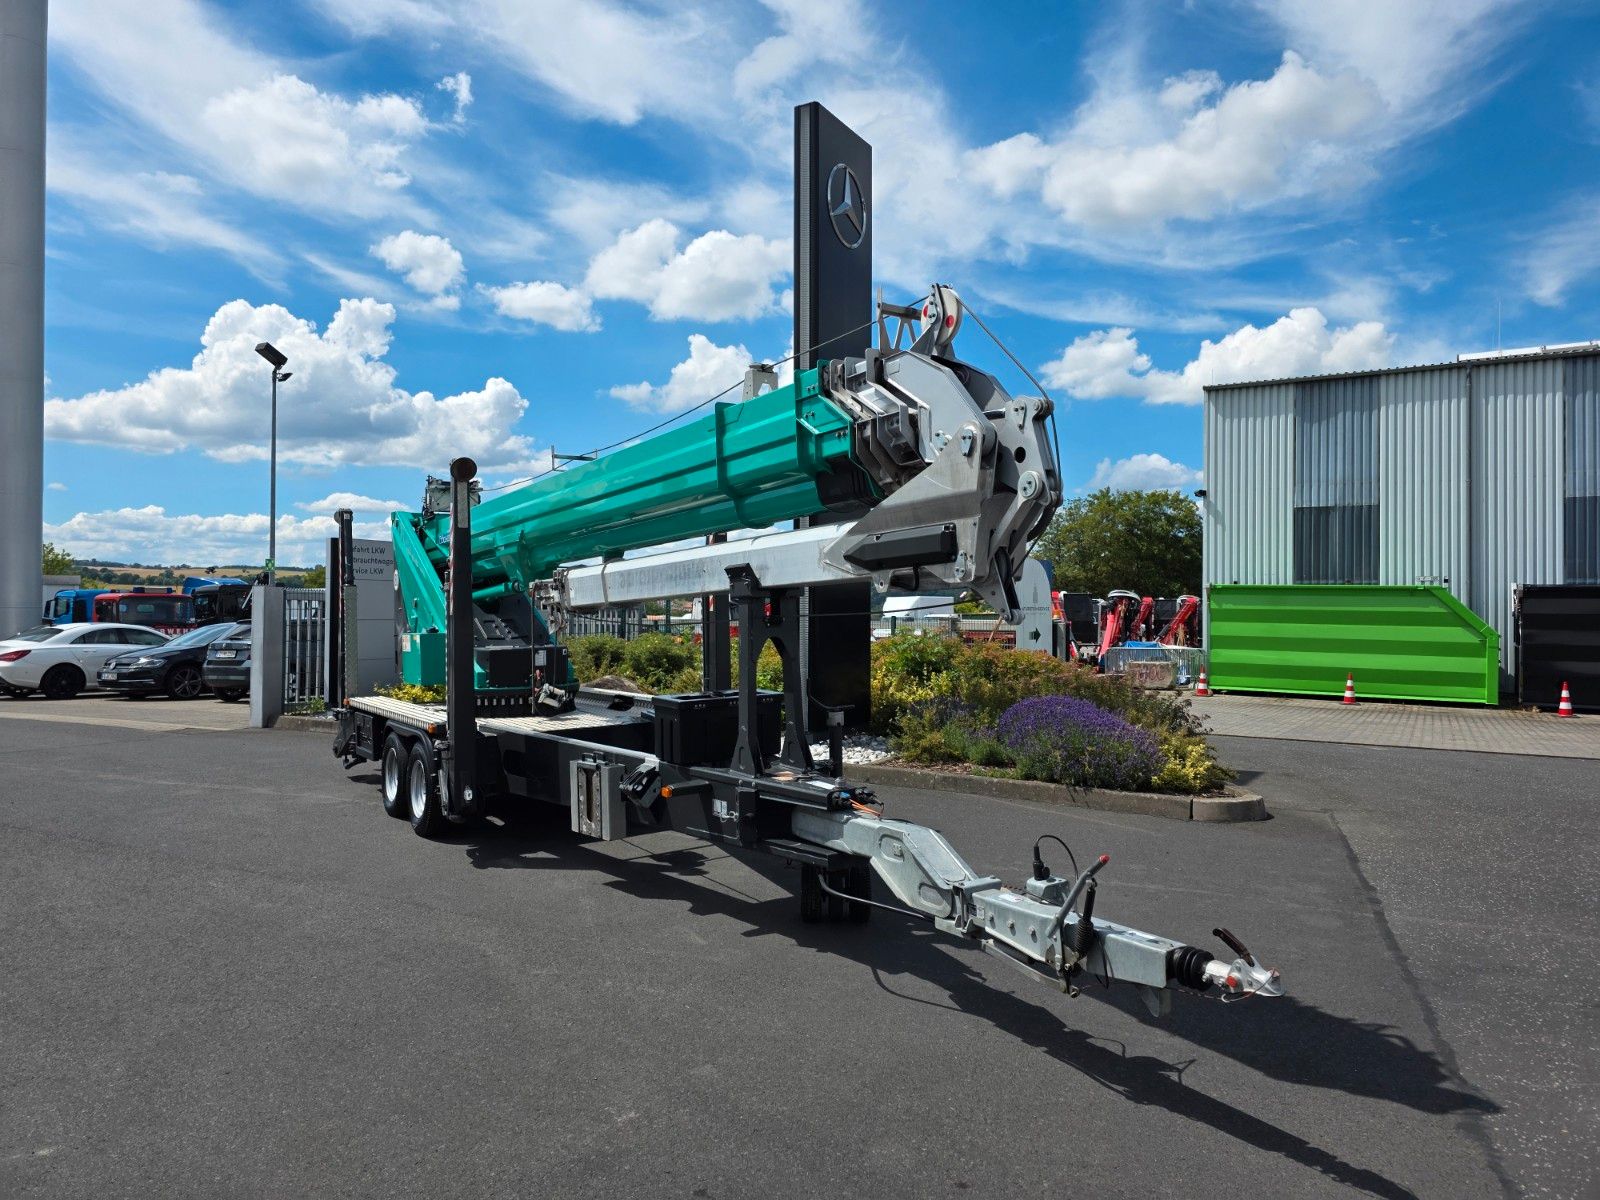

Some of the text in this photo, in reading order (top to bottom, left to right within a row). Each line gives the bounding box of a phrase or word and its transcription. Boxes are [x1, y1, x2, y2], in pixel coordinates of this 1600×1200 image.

[352, 545, 385, 554] fahrt LKW
[353, 557, 394, 566] brauchtwage
[369, 567, 384, 575] LKW
